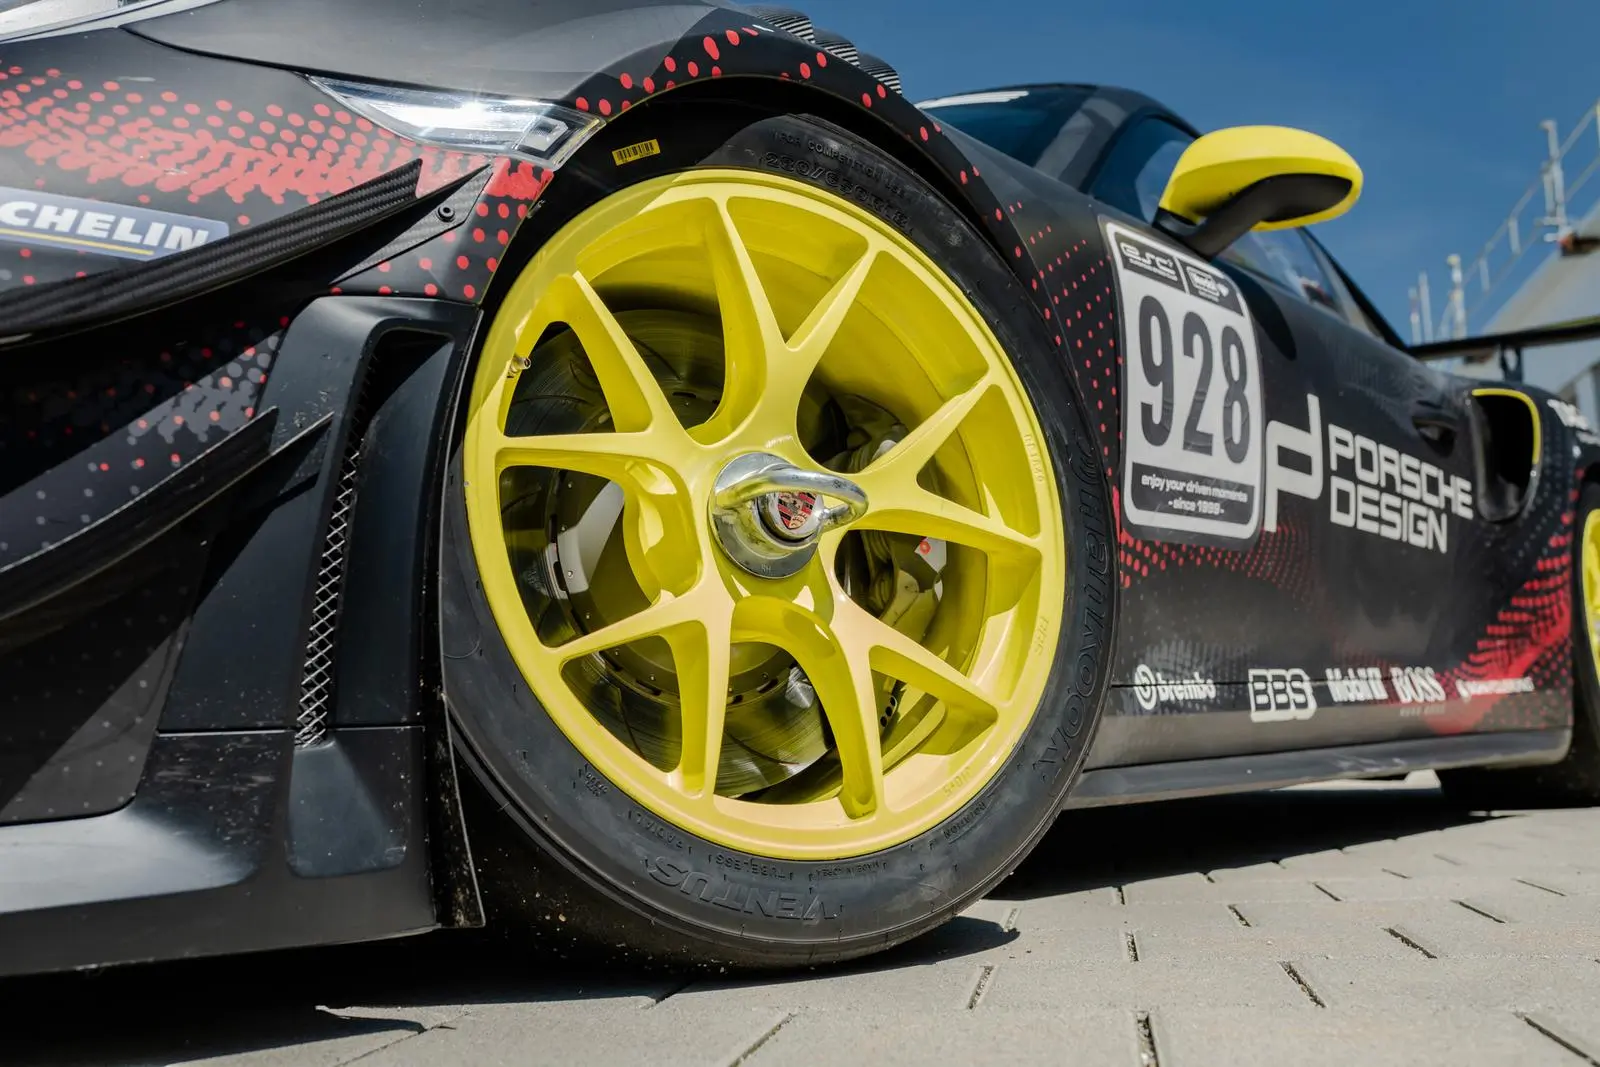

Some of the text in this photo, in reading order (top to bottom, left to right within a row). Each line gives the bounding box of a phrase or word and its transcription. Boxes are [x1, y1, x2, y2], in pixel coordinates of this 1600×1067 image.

[0, 201, 209, 250] CHELIN
[1139, 295, 1250, 463] 928
[1141, 474, 1165, 491] enjoy
[1165, 478, 1186, 492] your
[1186, 481, 1212, 496] driven
[1328, 423, 1473, 520] PORSCHE
[1330, 475, 1447, 554] DESIGN
[1156, 671, 1216, 701] brembo
[1248, 668, 1318, 723] BBS
[1390, 666, 1446, 703] BOSS
[647, 855, 836, 924] VENTUS
[715, 853, 787, 880] TUBELESS
